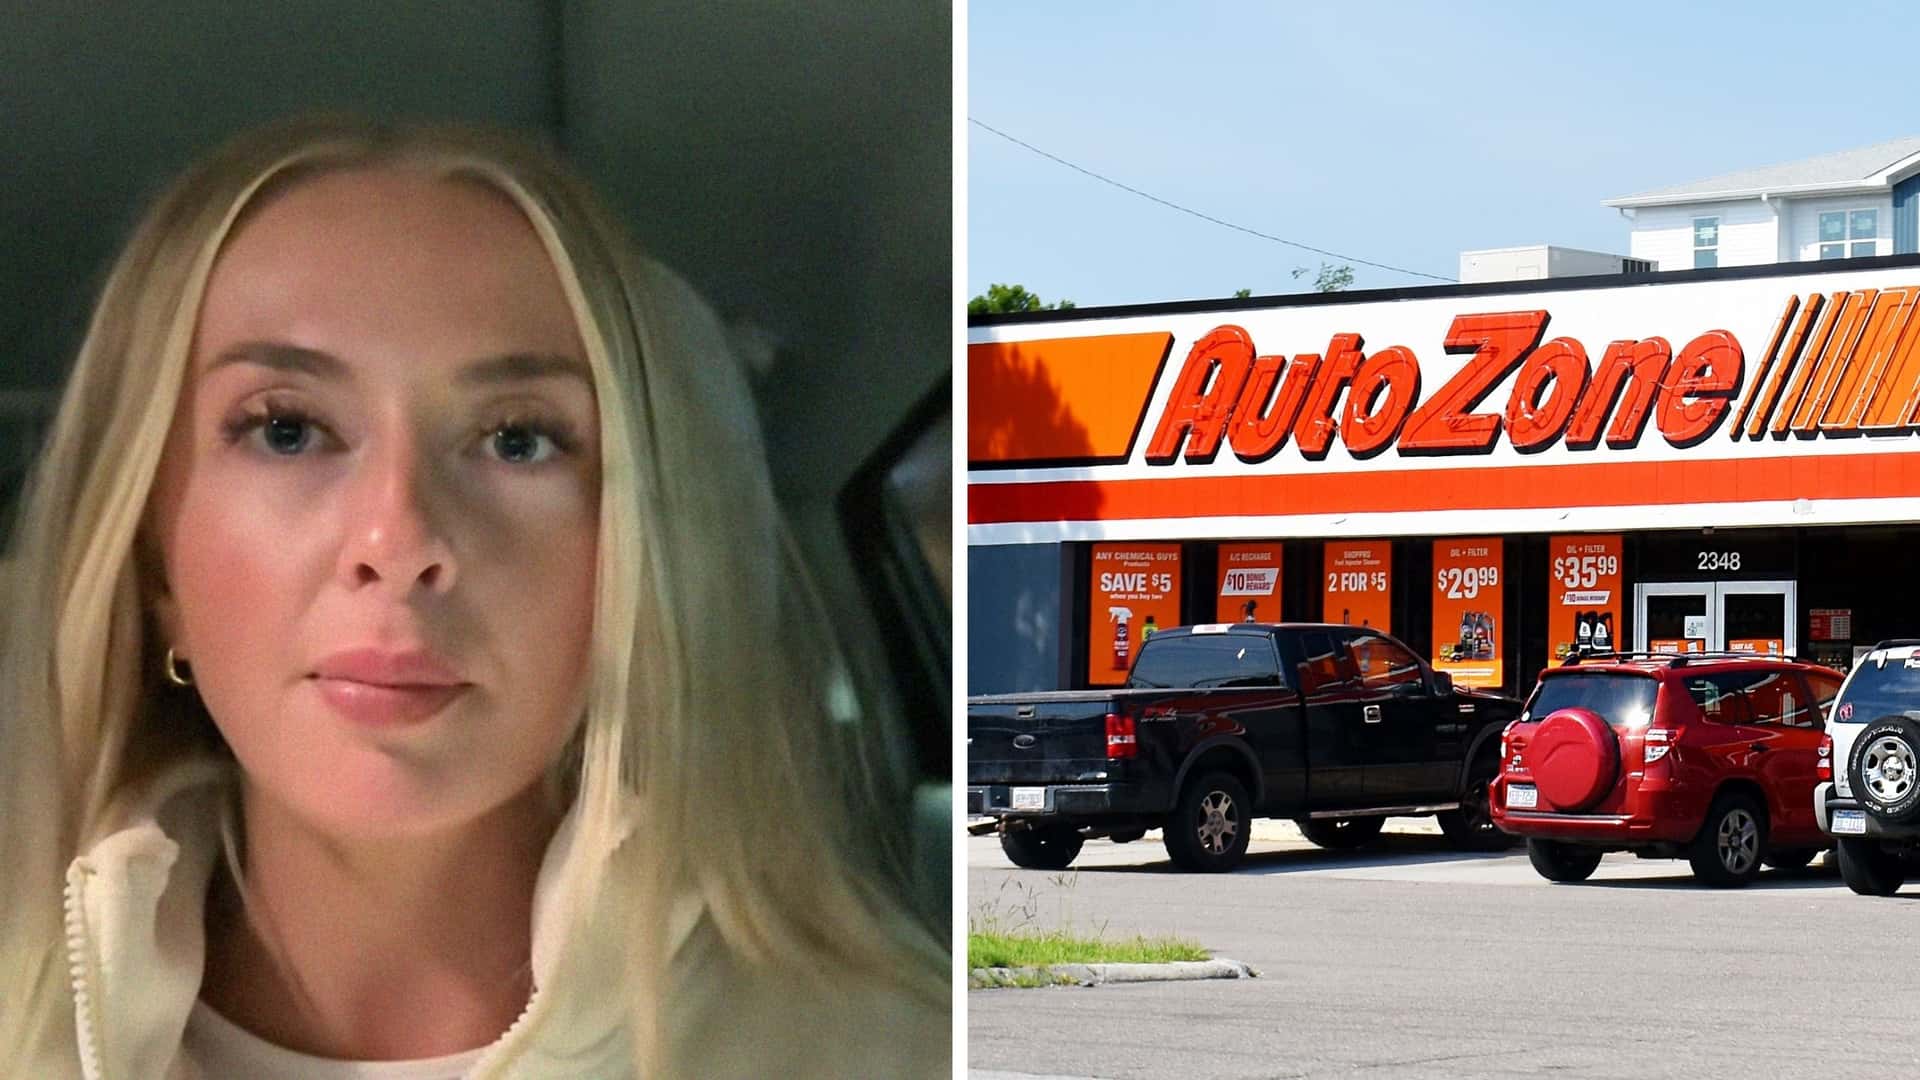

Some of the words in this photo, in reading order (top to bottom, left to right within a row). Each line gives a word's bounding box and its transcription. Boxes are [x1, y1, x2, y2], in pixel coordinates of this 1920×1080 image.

[1145, 309, 1744, 466] AutoZone
[1096, 552, 1113, 560] ANY
[1114, 552, 1155, 560] CHEMICAL
[1156, 552, 1179, 561] GUYS
[1467, 548, 1488, 557] FILTER
[1584, 545, 1605, 553] FILTER
[1697, 551, 1741, 570] 2348
[1100, 572, 1147, 592] SAVE
[1151, 573, 1172, 592] $5
[1227, 573, 1245, 591] $10
[1328, 572, 1338, 592] 2
[1341, 572, 1367, 592] FOR
[1371, 571, 1387, 592] $5
